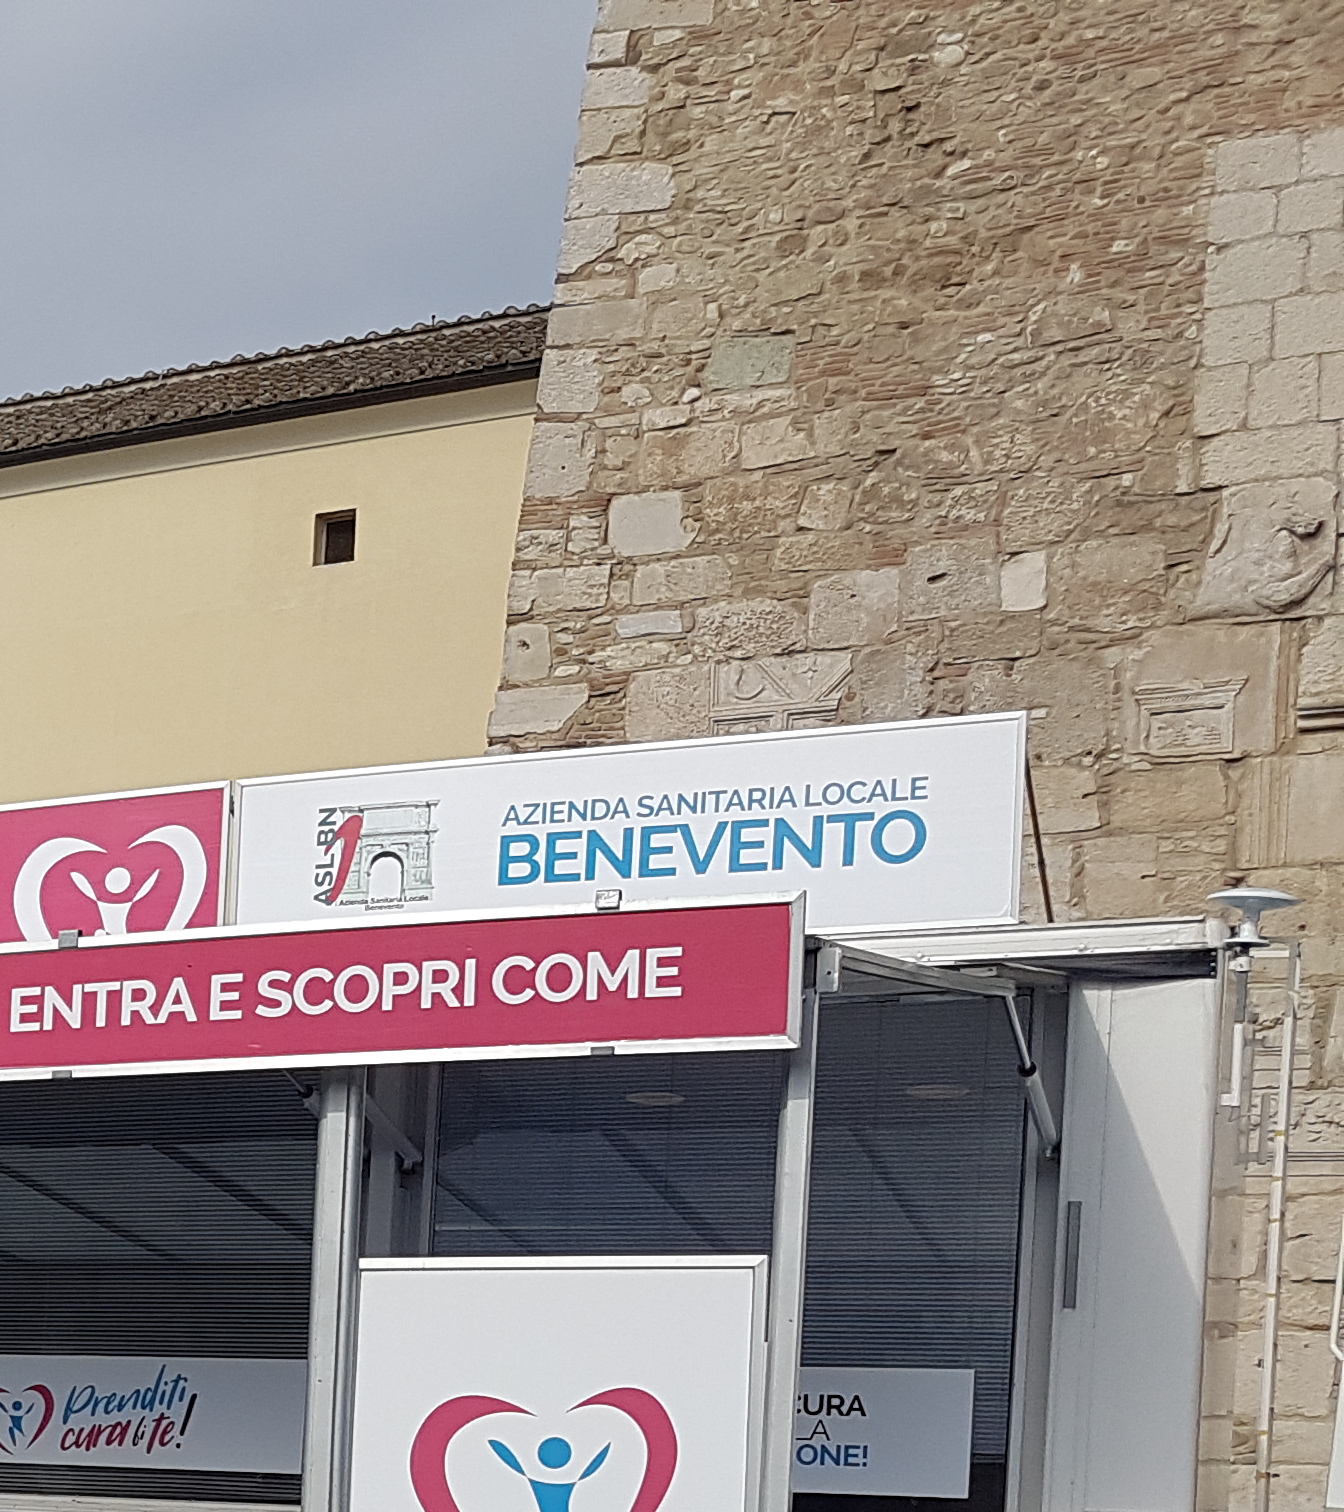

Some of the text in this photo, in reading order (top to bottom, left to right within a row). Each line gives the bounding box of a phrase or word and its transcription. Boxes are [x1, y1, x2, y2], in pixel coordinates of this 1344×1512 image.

[501, 776, 929, 827] AZIENDA SANITARIA LOCALE
[497, 809, 927, 886] BENEVENTO
[9, 946, 683, 1032] ENTRA E SCOPRI COME
[62, 1364, 188, 1425] Prenditi
[797, 1394, 867, 1417] URA
[60, 1419, 132, 1452] cura
